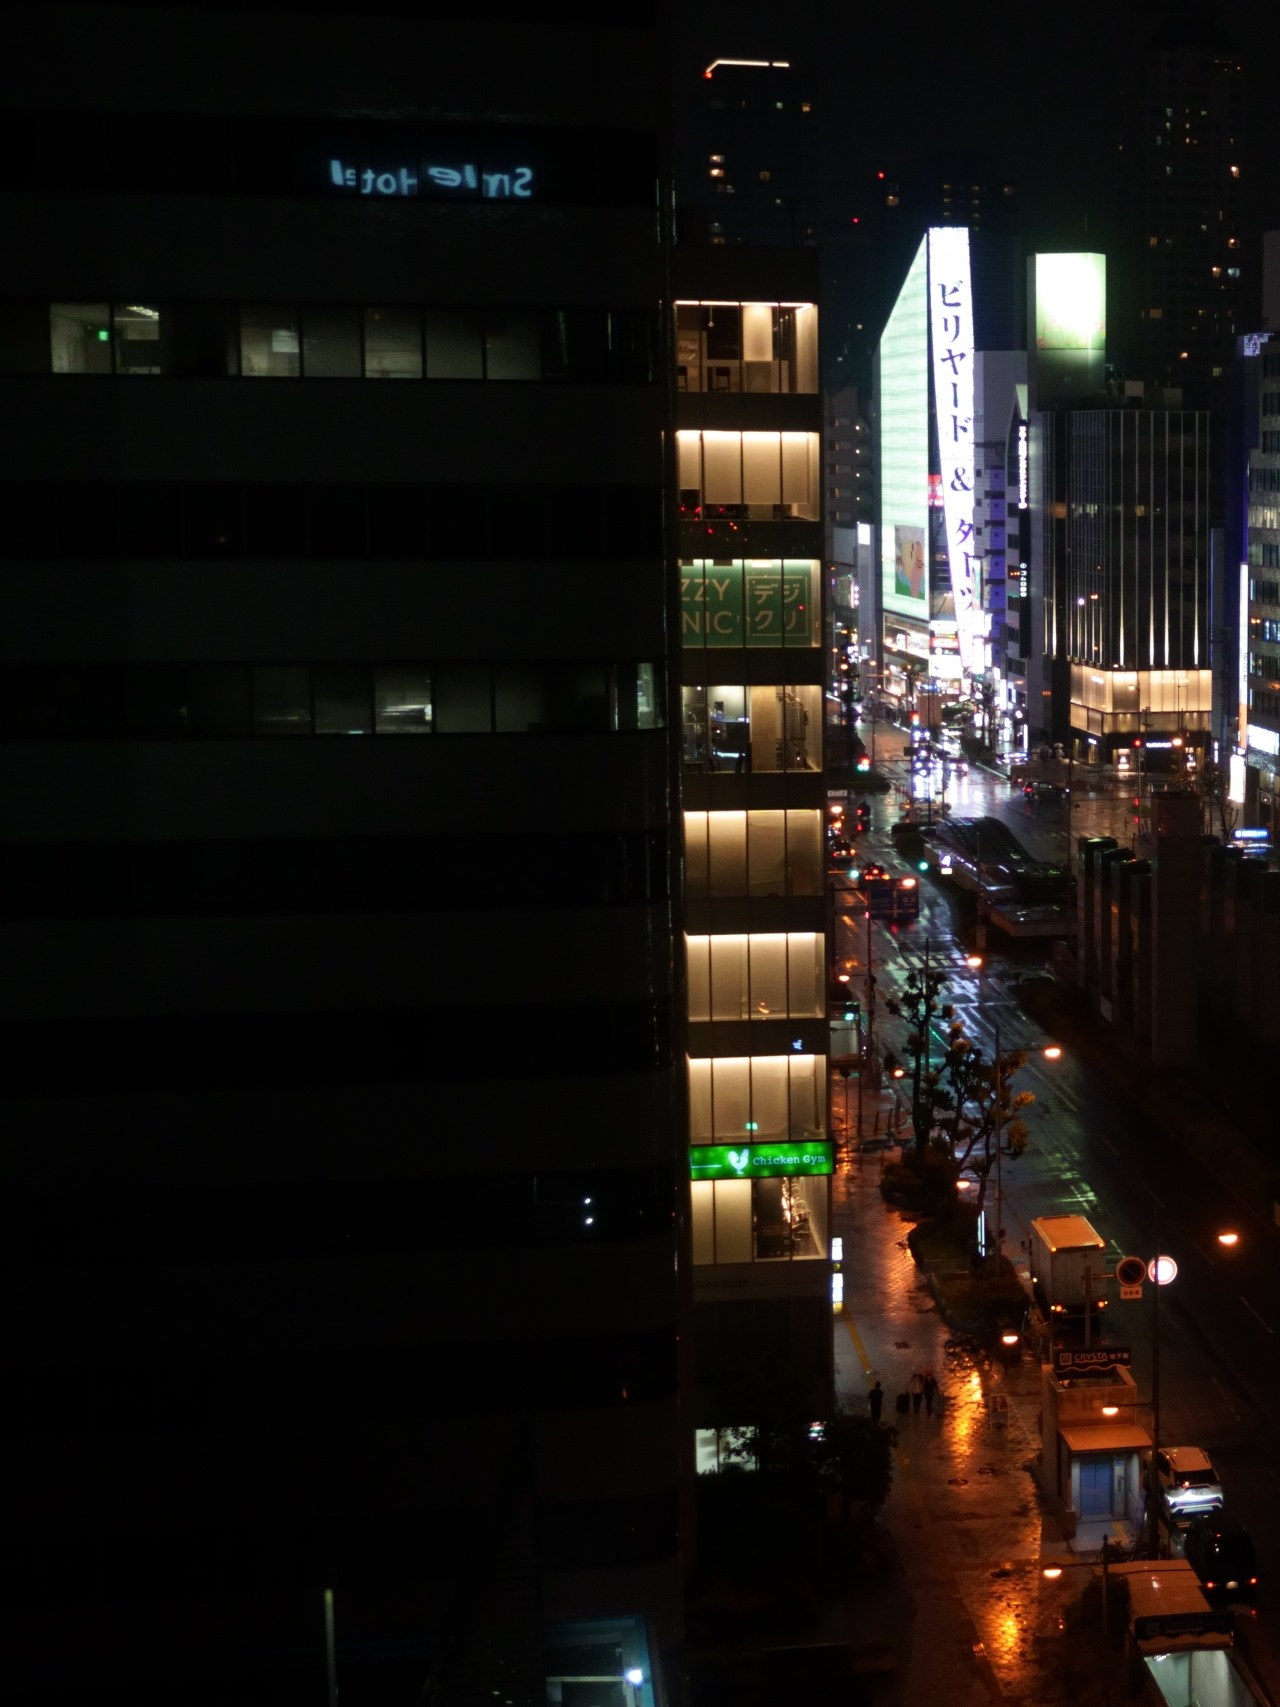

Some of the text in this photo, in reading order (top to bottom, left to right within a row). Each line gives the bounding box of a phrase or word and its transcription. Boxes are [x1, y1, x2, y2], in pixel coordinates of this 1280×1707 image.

[938, 280, 972, 443] ビリヤード
[950, 467, 974, 492] &
[754, 583, 800, 604] デジ
[682, 610, 733, 634] NIC
[755, 610, 797, 630] クリ
[753, 1154, 826, 1165] Chicken Gym
[1074, 1352, 1108, 1361] CRYSTA
